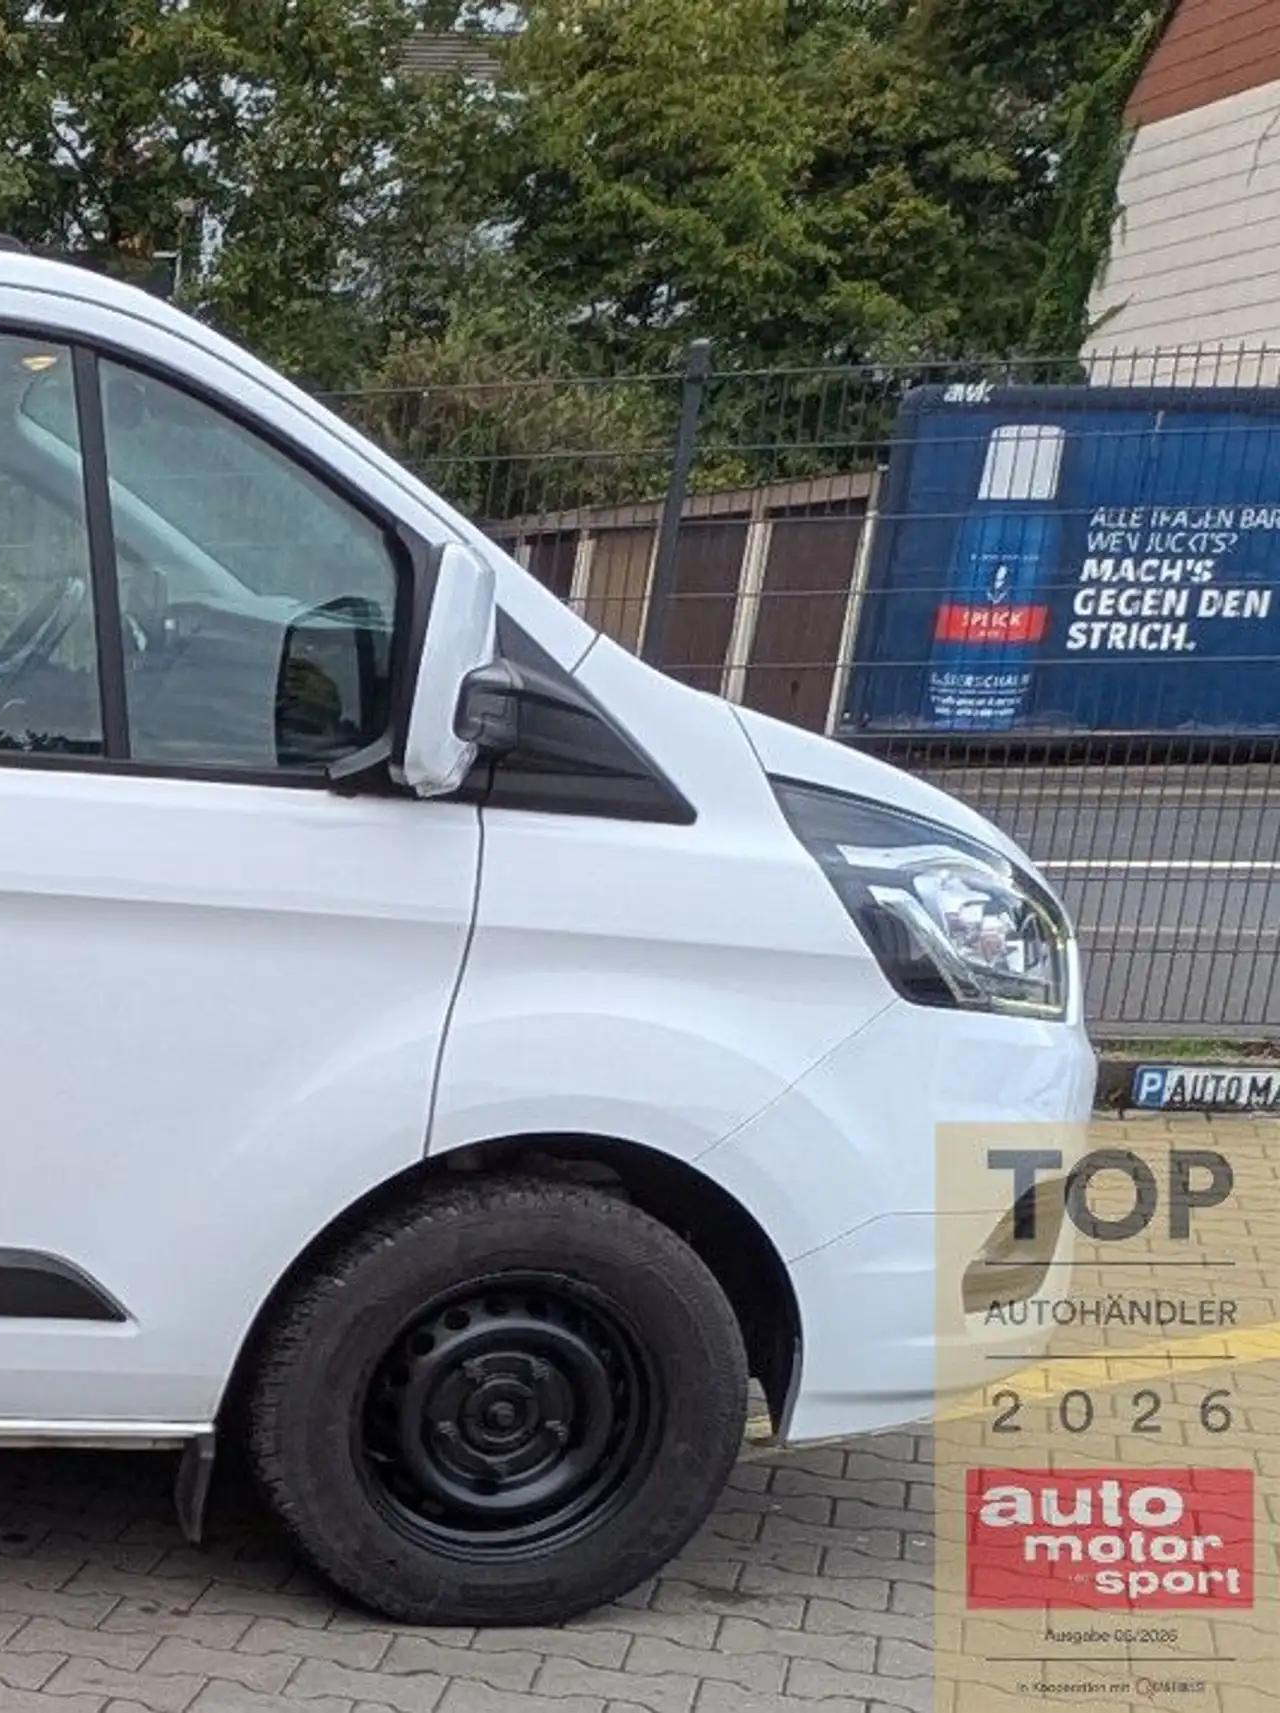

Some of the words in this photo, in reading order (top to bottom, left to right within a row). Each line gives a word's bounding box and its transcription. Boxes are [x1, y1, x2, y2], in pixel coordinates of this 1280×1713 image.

[1080, 558, 1216, 582] MACH'S
[1073, 587, 1191, 617] GEGEN
[1196, 589, 1273, 618] DEN
[1066, 621, 1198, 651] STRICH.
